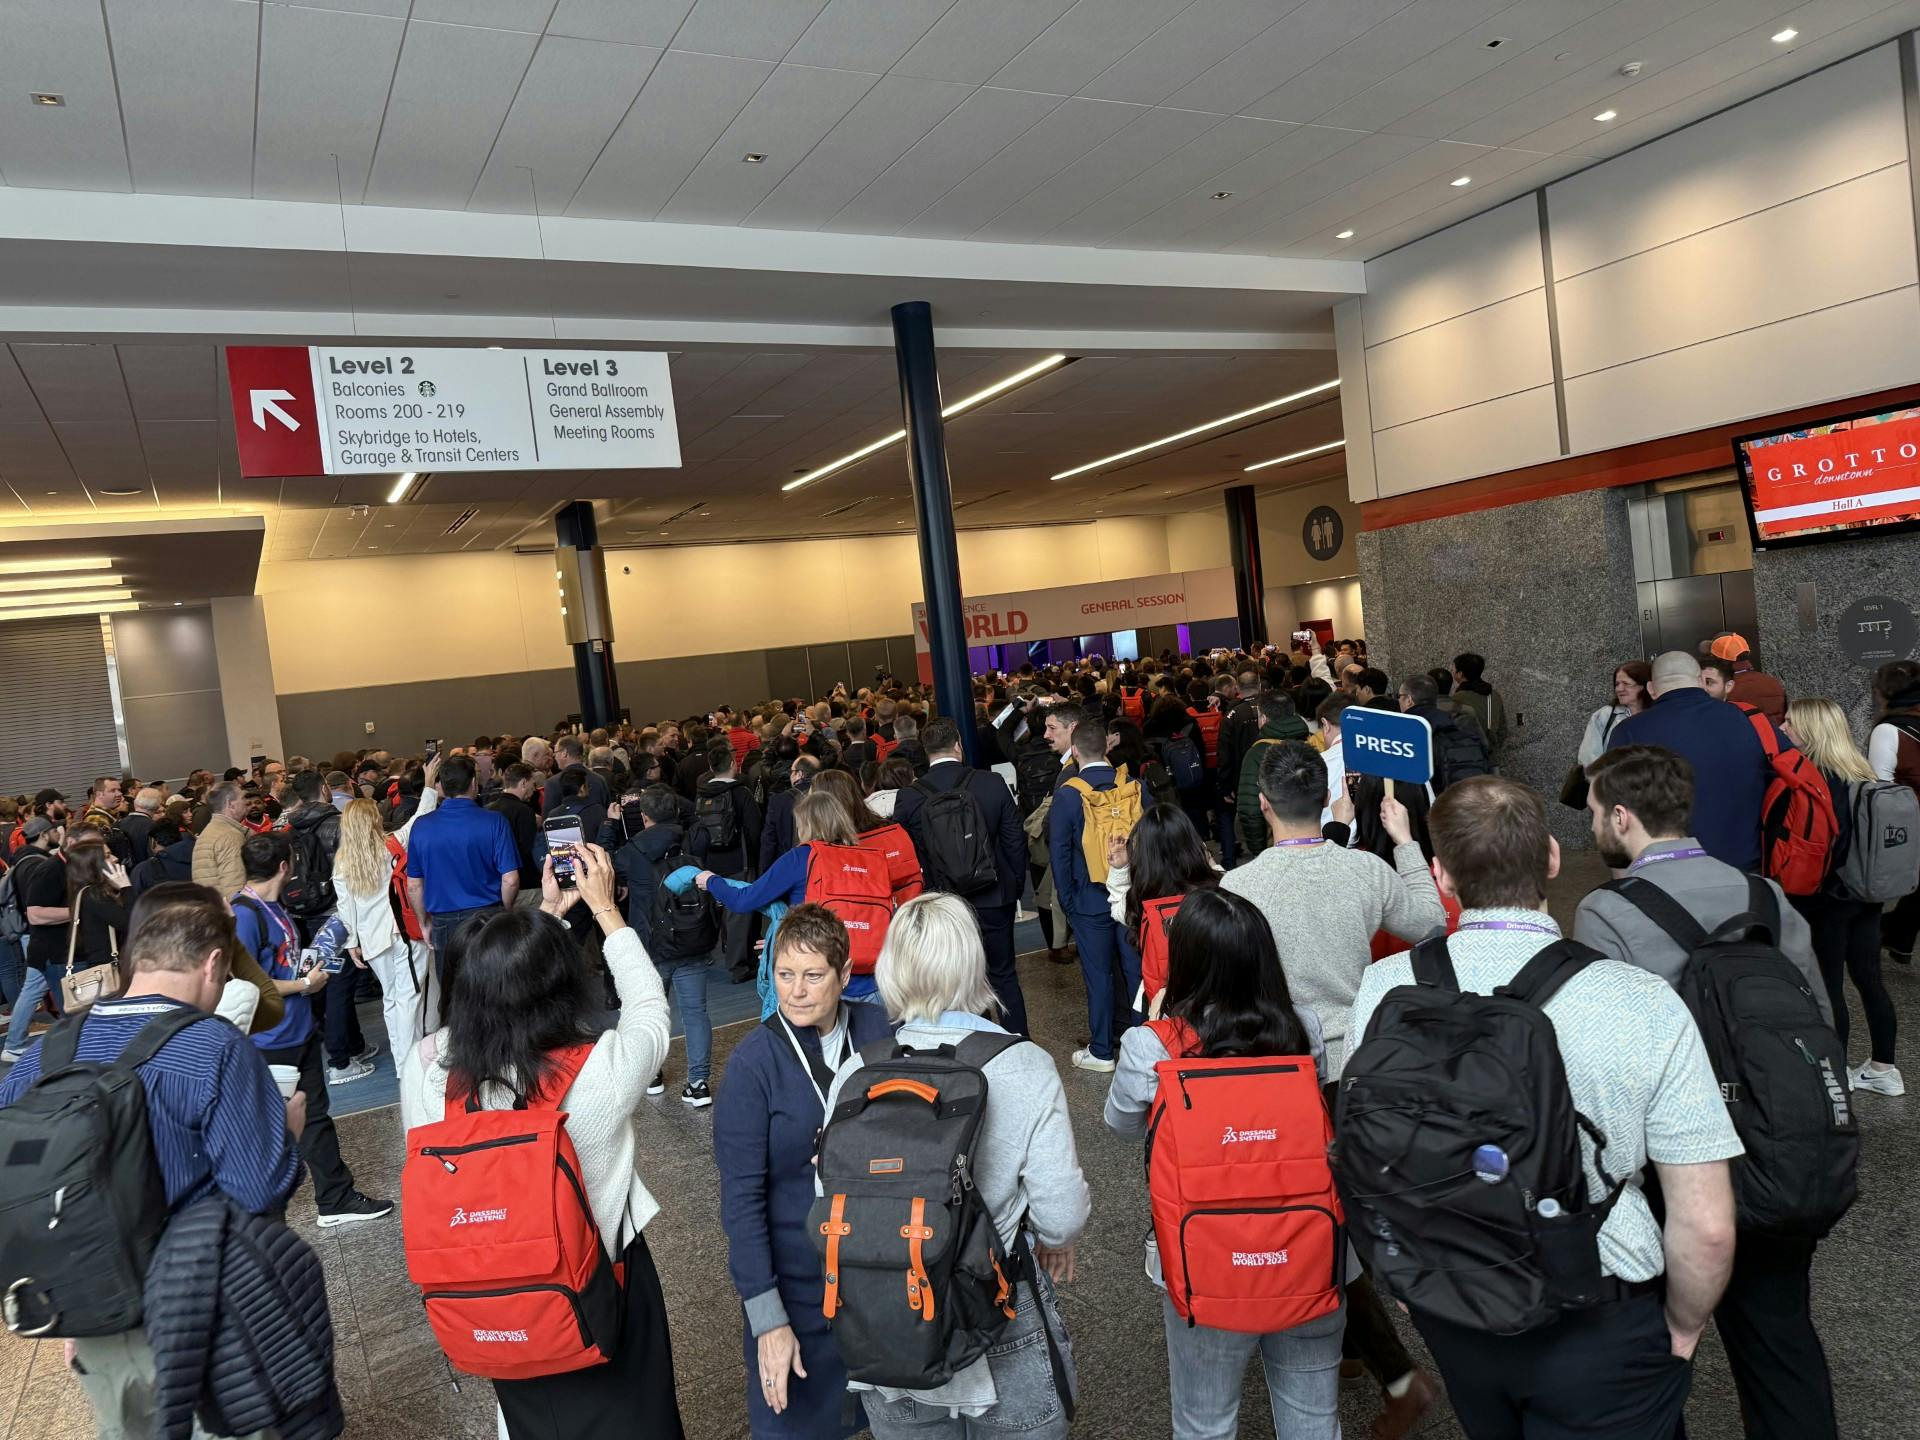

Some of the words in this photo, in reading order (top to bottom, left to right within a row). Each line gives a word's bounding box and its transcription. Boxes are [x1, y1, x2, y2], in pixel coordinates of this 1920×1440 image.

[329, 356, 392, 374] Level
[400, 356, 415, 374] 2
[544, 358, 598, 376] Level
[606, 360, 618, 376] 3
[332, 382, 405, 396] Balconies
[547, 382, 587, 396] Grand
[591, 383, 648, 398] Ballroom
[336, 404, 388, 419] Rooms
[393, 404, 422, 418] 200
[436, 404, 465, 418] 219
[550, 404, 602, 418] General
[605, 404, 664, 421] Assembly
[338, 430, 410, 448] Skybridge
[415, 430, 428, 444] to
[433, 429, 482, 444] Hotels,
[554, 425, 608, 442] Meeting
[611, 425, 654, 438] Rooms
[341, 450, 396, 468] Garage
[401, 449, 413, 464] &
[415, 448, 461, 462] Transit
[466, 448, 520, 462] Centers
[1768, 444, 1916, 481] GROTTO
[1814, 468, 1874, 485] downtown
[1832, 499, 1853, 510] Hall
[1855, 498, 1864, 507] A
[1081, 600, 1134, 614] GENERAL
[1136, 592, 1184, 608] SESSION
[1355, 734, 1414, 758] PRESS
[1820, 1056, 1848, 1126] THULE
[469, 1208, 508, 1218] DASSAULT
[1266, 1256, 1288, 1265] 2025
